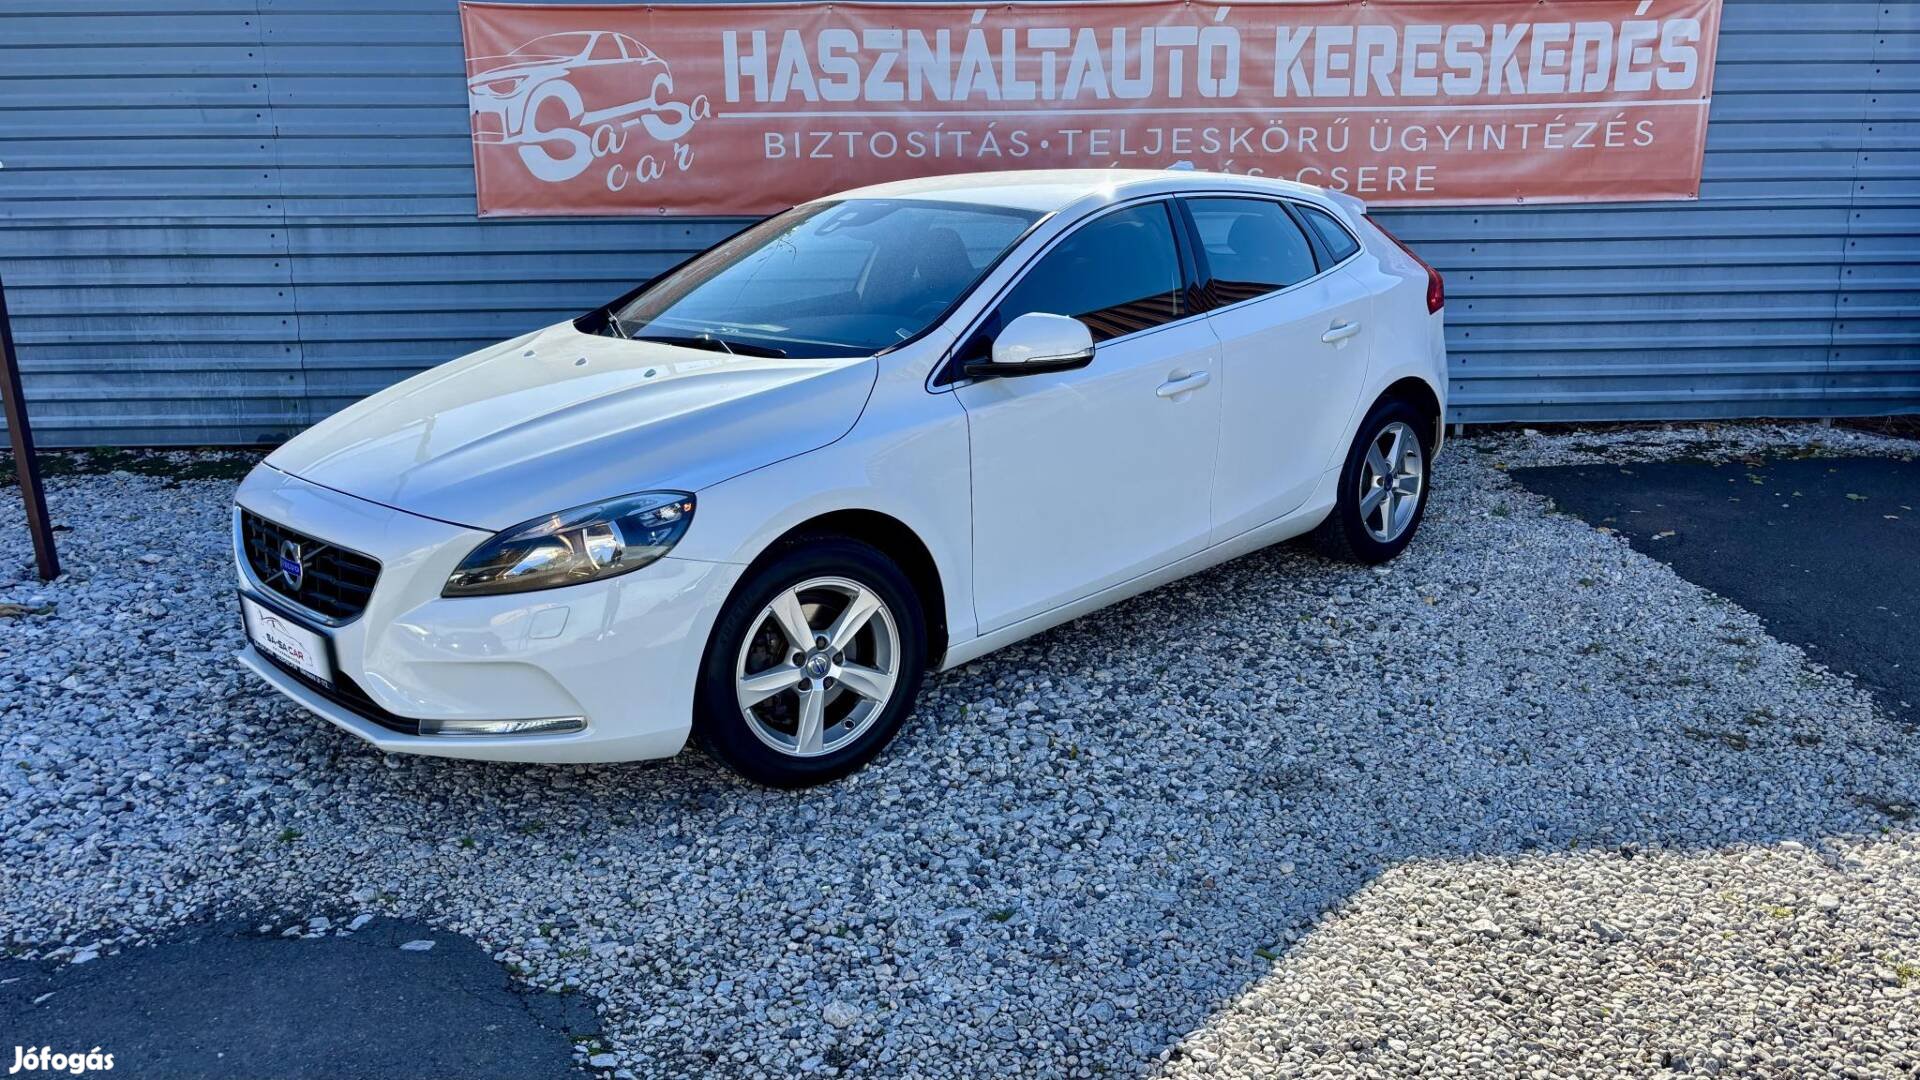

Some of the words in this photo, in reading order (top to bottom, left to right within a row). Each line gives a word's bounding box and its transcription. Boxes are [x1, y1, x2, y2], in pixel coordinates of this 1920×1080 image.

[722, 7, 1241, 103] HASZNÁLTAUTÓ
[1273, 0, 1700, 97] KERESKEDÉS
[764, 122, 1029, 159] BIZTOSÍTÁS
[1058, 118, 1349, 156] TELJESKÖRŰ
[1370, 112, 1654, 152] ÜGYINTÉZÉS
[606, 142, 695, 192] car
[1296, 165, 1437, 193] CSERE
